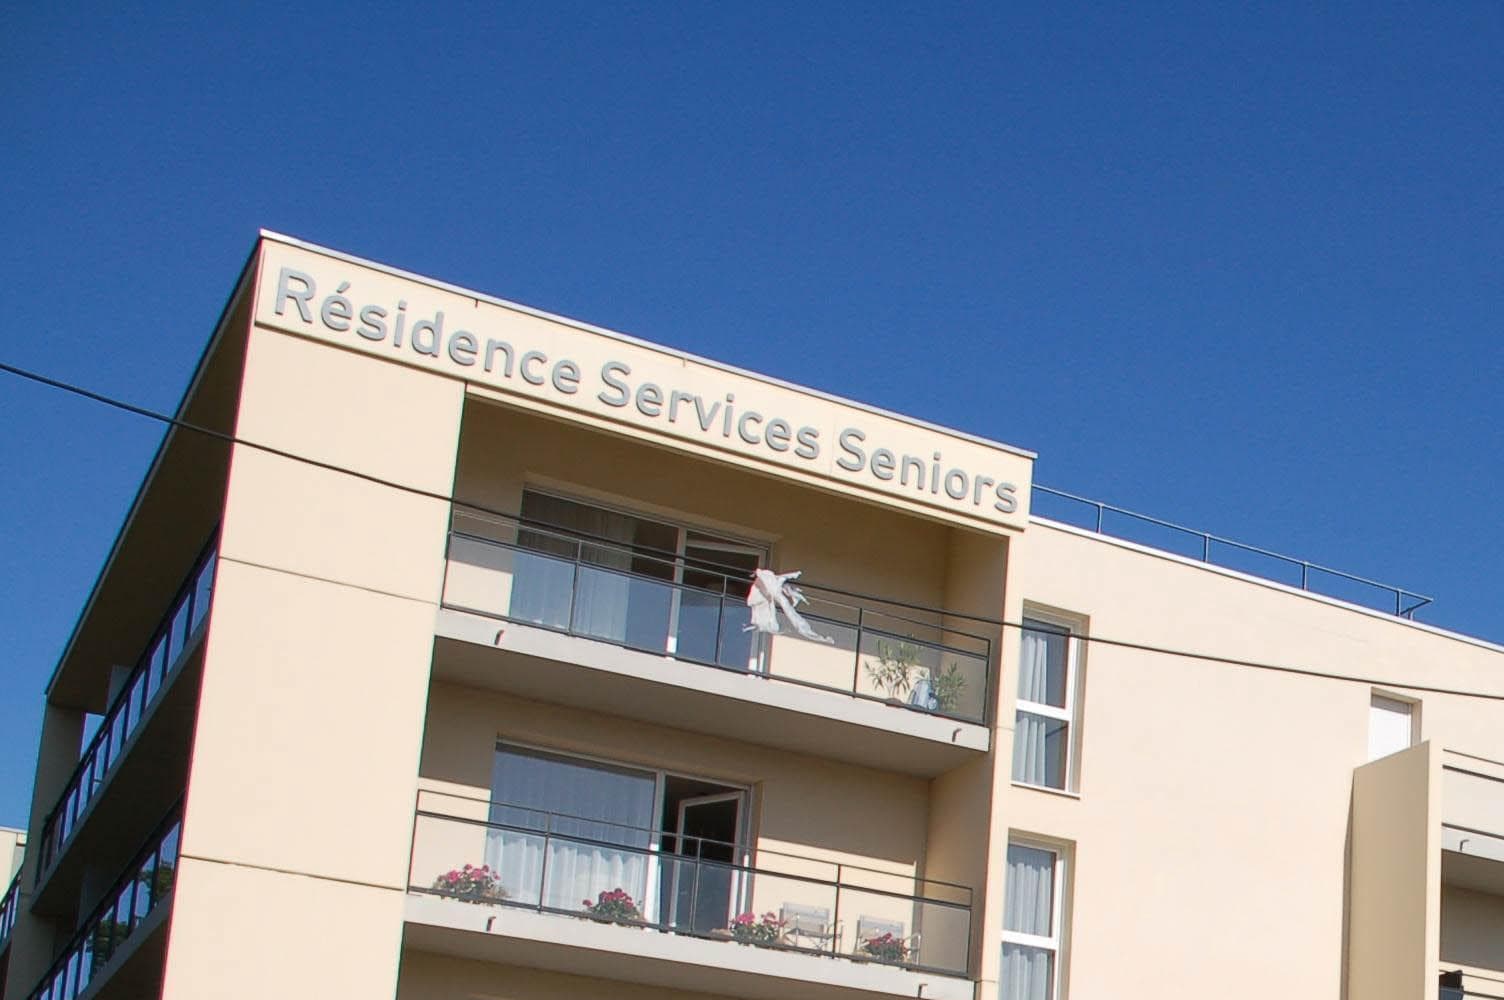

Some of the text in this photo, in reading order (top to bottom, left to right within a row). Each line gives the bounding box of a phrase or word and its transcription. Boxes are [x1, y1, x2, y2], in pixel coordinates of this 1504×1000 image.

[275, 267, 1020, 516] Résidence Services Seniors
